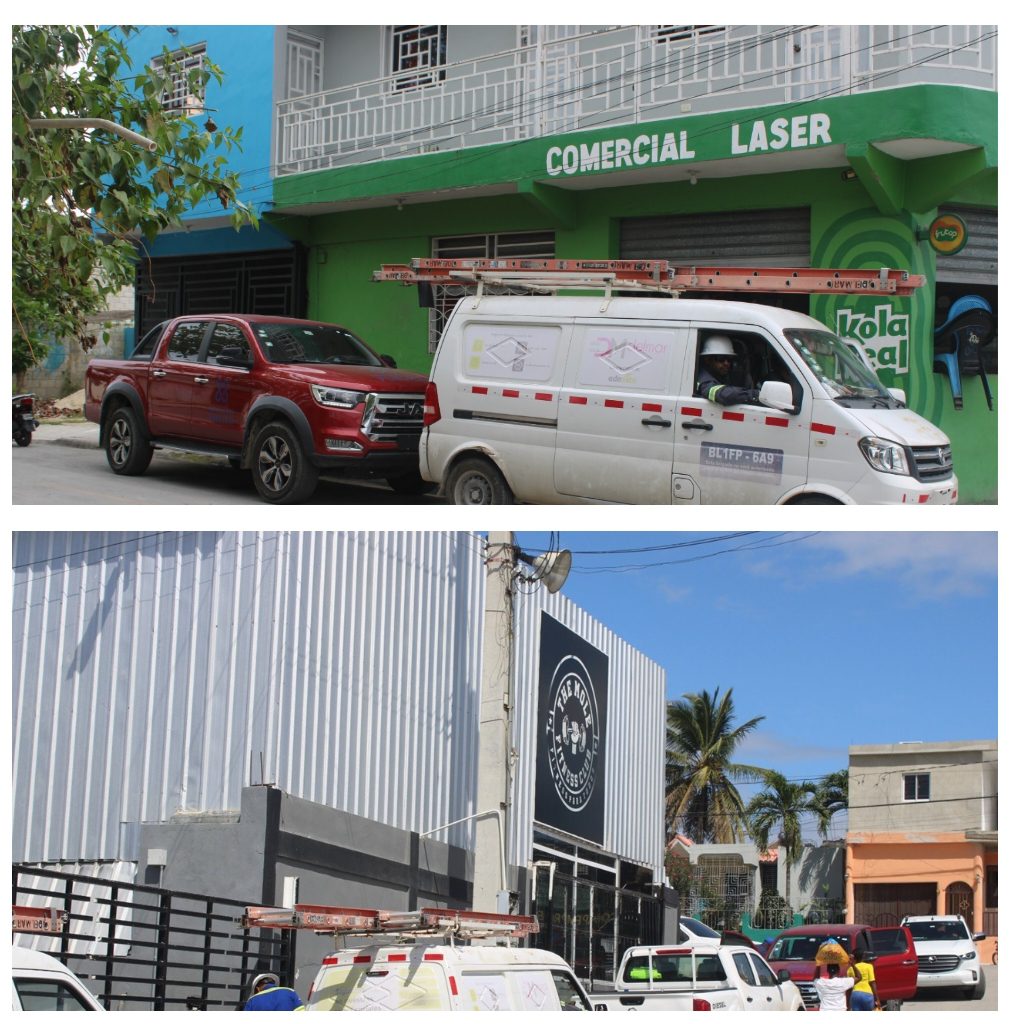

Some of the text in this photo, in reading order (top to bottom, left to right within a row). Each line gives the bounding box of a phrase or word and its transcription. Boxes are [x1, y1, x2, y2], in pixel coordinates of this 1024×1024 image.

[546, 113, 832, 176] COMERCIAL LASER
[708, 446, 743, 461] BL1FP
[752, 451, 775, 464] 6A9
[556, 680, 592, 729] THE MOLE
[555, 734, 592, 788] FITNESS CLUB
